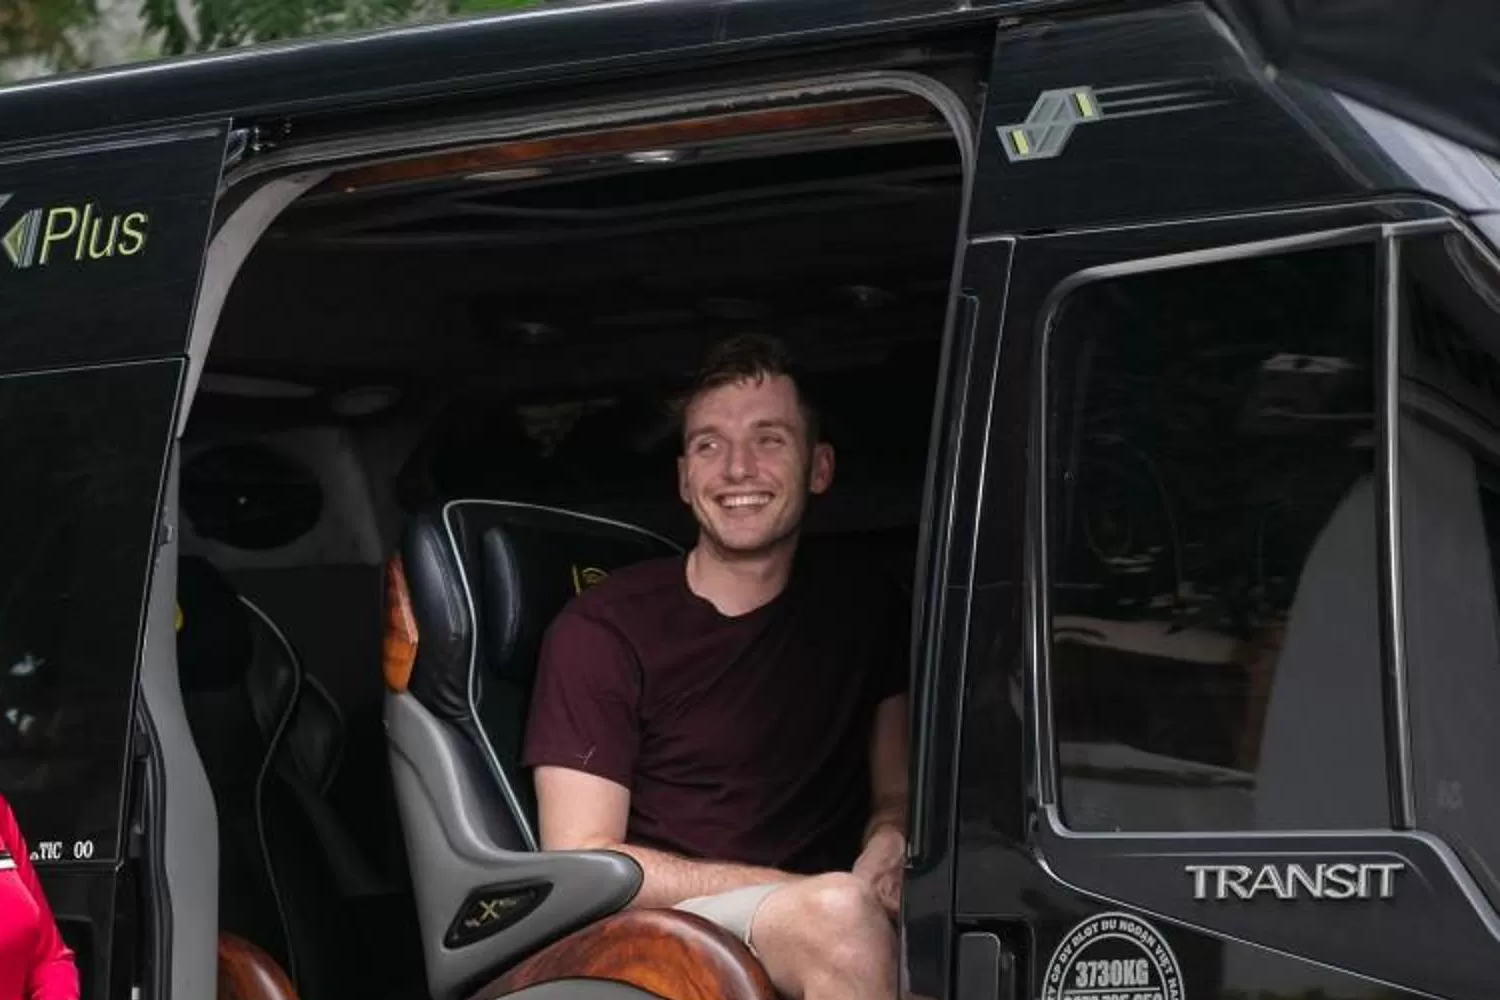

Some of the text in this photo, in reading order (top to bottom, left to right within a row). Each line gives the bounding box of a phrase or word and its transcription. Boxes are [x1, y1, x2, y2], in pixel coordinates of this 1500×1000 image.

[38, 204, 149, 266] Plus
[1185, 863, 1405, 898] TRANSIT
[1075, 957, 1149, 989] 3730KG
